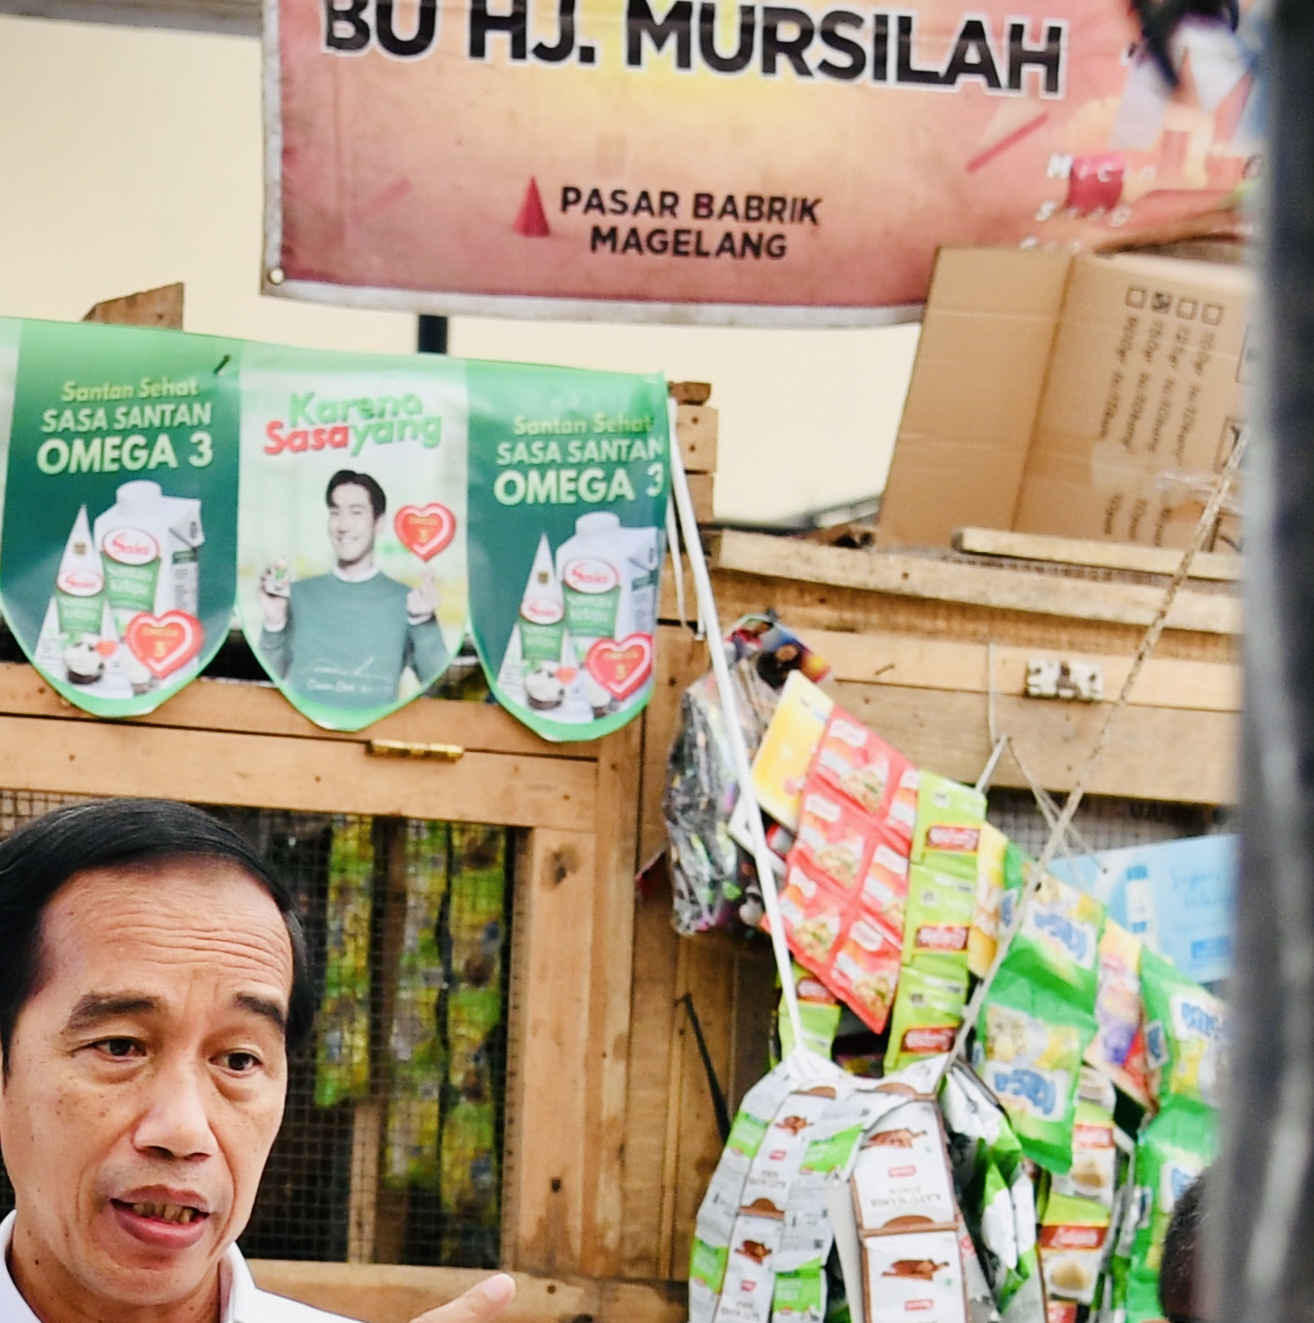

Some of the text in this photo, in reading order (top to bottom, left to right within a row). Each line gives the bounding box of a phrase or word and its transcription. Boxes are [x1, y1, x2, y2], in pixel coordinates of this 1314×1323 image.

[325, 0, 1062, 94] BU HJ. MURSILAH
[561, 186, 823, 225] PASAR BABRIK
[590, 226, 788, 259] MAGELANG
[61, 377, 198, 403] Santan Sehat
[41, 402, 212, 433] SASA SANTAN
[289, 391, 424, 428] Karena
[514, 413, 655, 436] Santan Sehat
[36, 431, 214, 475] OMEGA 3
[264, 416, 442, 458] Sasayang
[496, 436, 665, 466] SASA SANTAN
[494, 462, 664, 506] OMEGA 3
